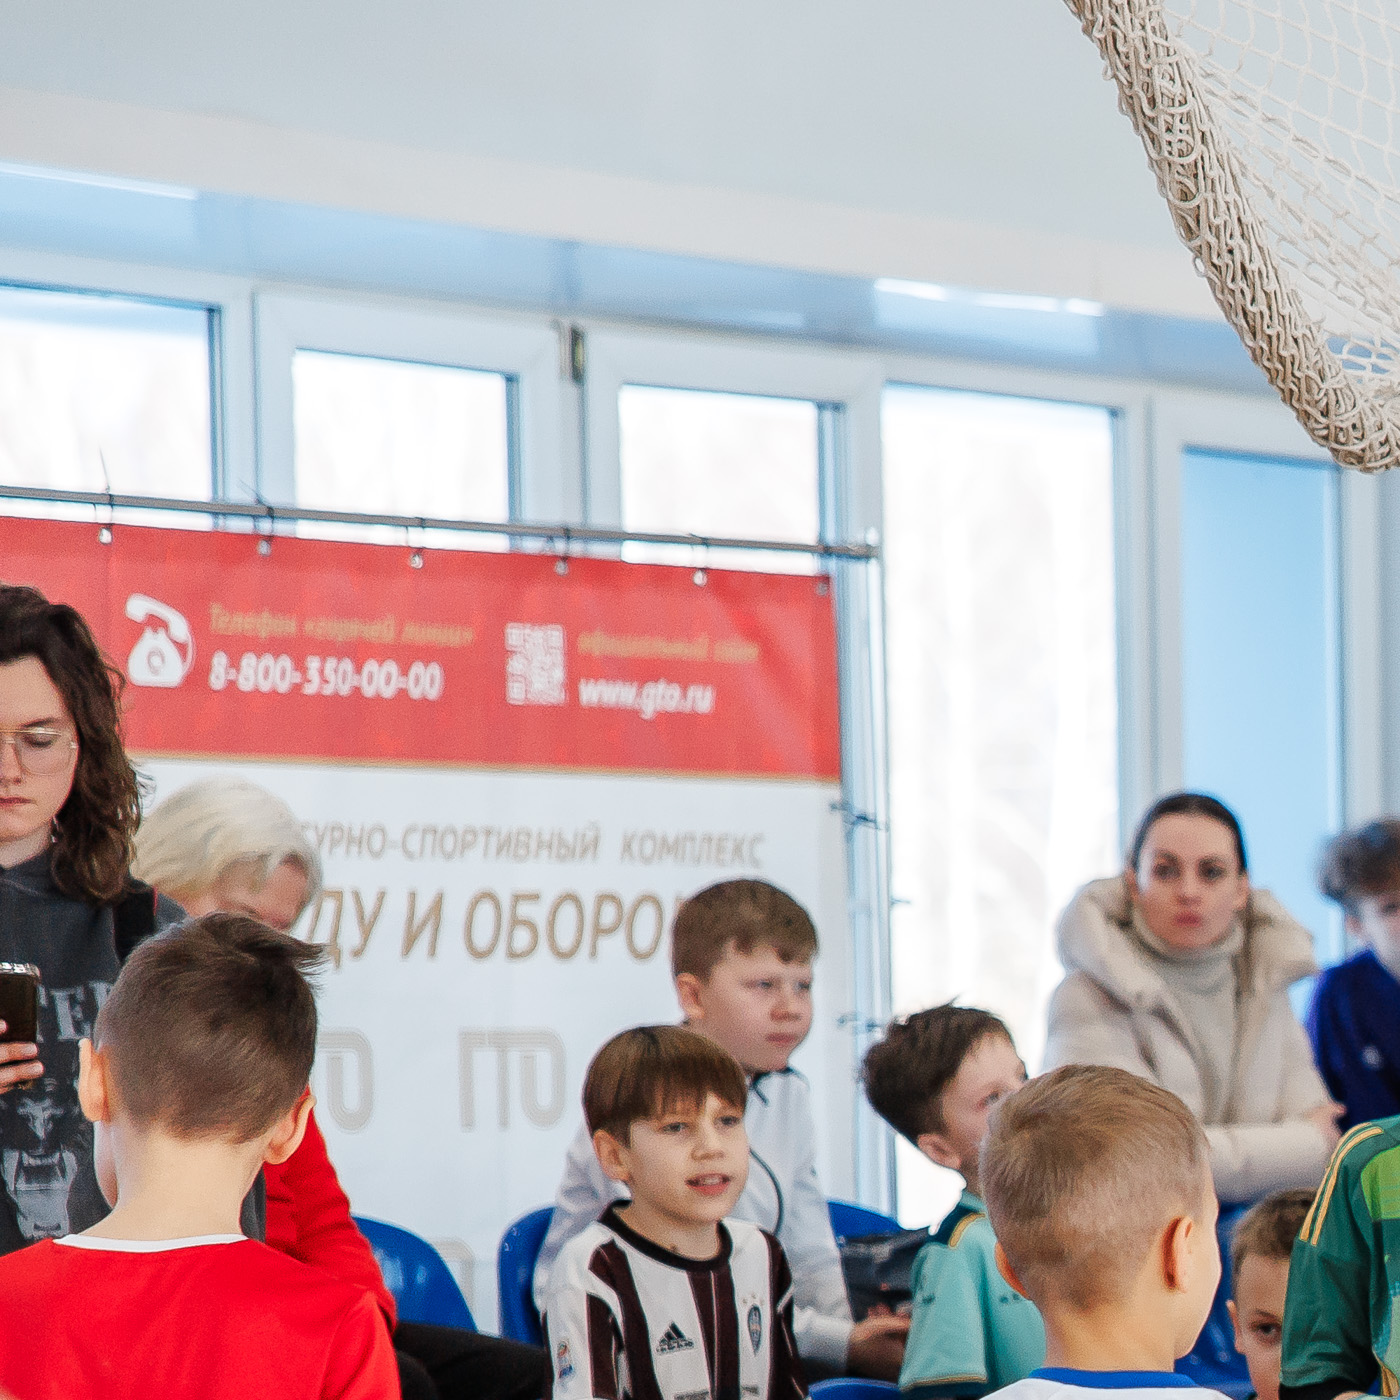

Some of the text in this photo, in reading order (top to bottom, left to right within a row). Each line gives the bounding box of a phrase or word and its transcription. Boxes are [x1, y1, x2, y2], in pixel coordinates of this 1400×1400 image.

[209, 650, 444, 701] 8-800-350-00-00
[579, 677, 715, 720] www.gto.ru
[303, 820, 767, 868] УРНО-СПОРТИВНЫЙ КОМПЛЕКС
[308, 889, 684, 969] ДУ И ОБОРО
